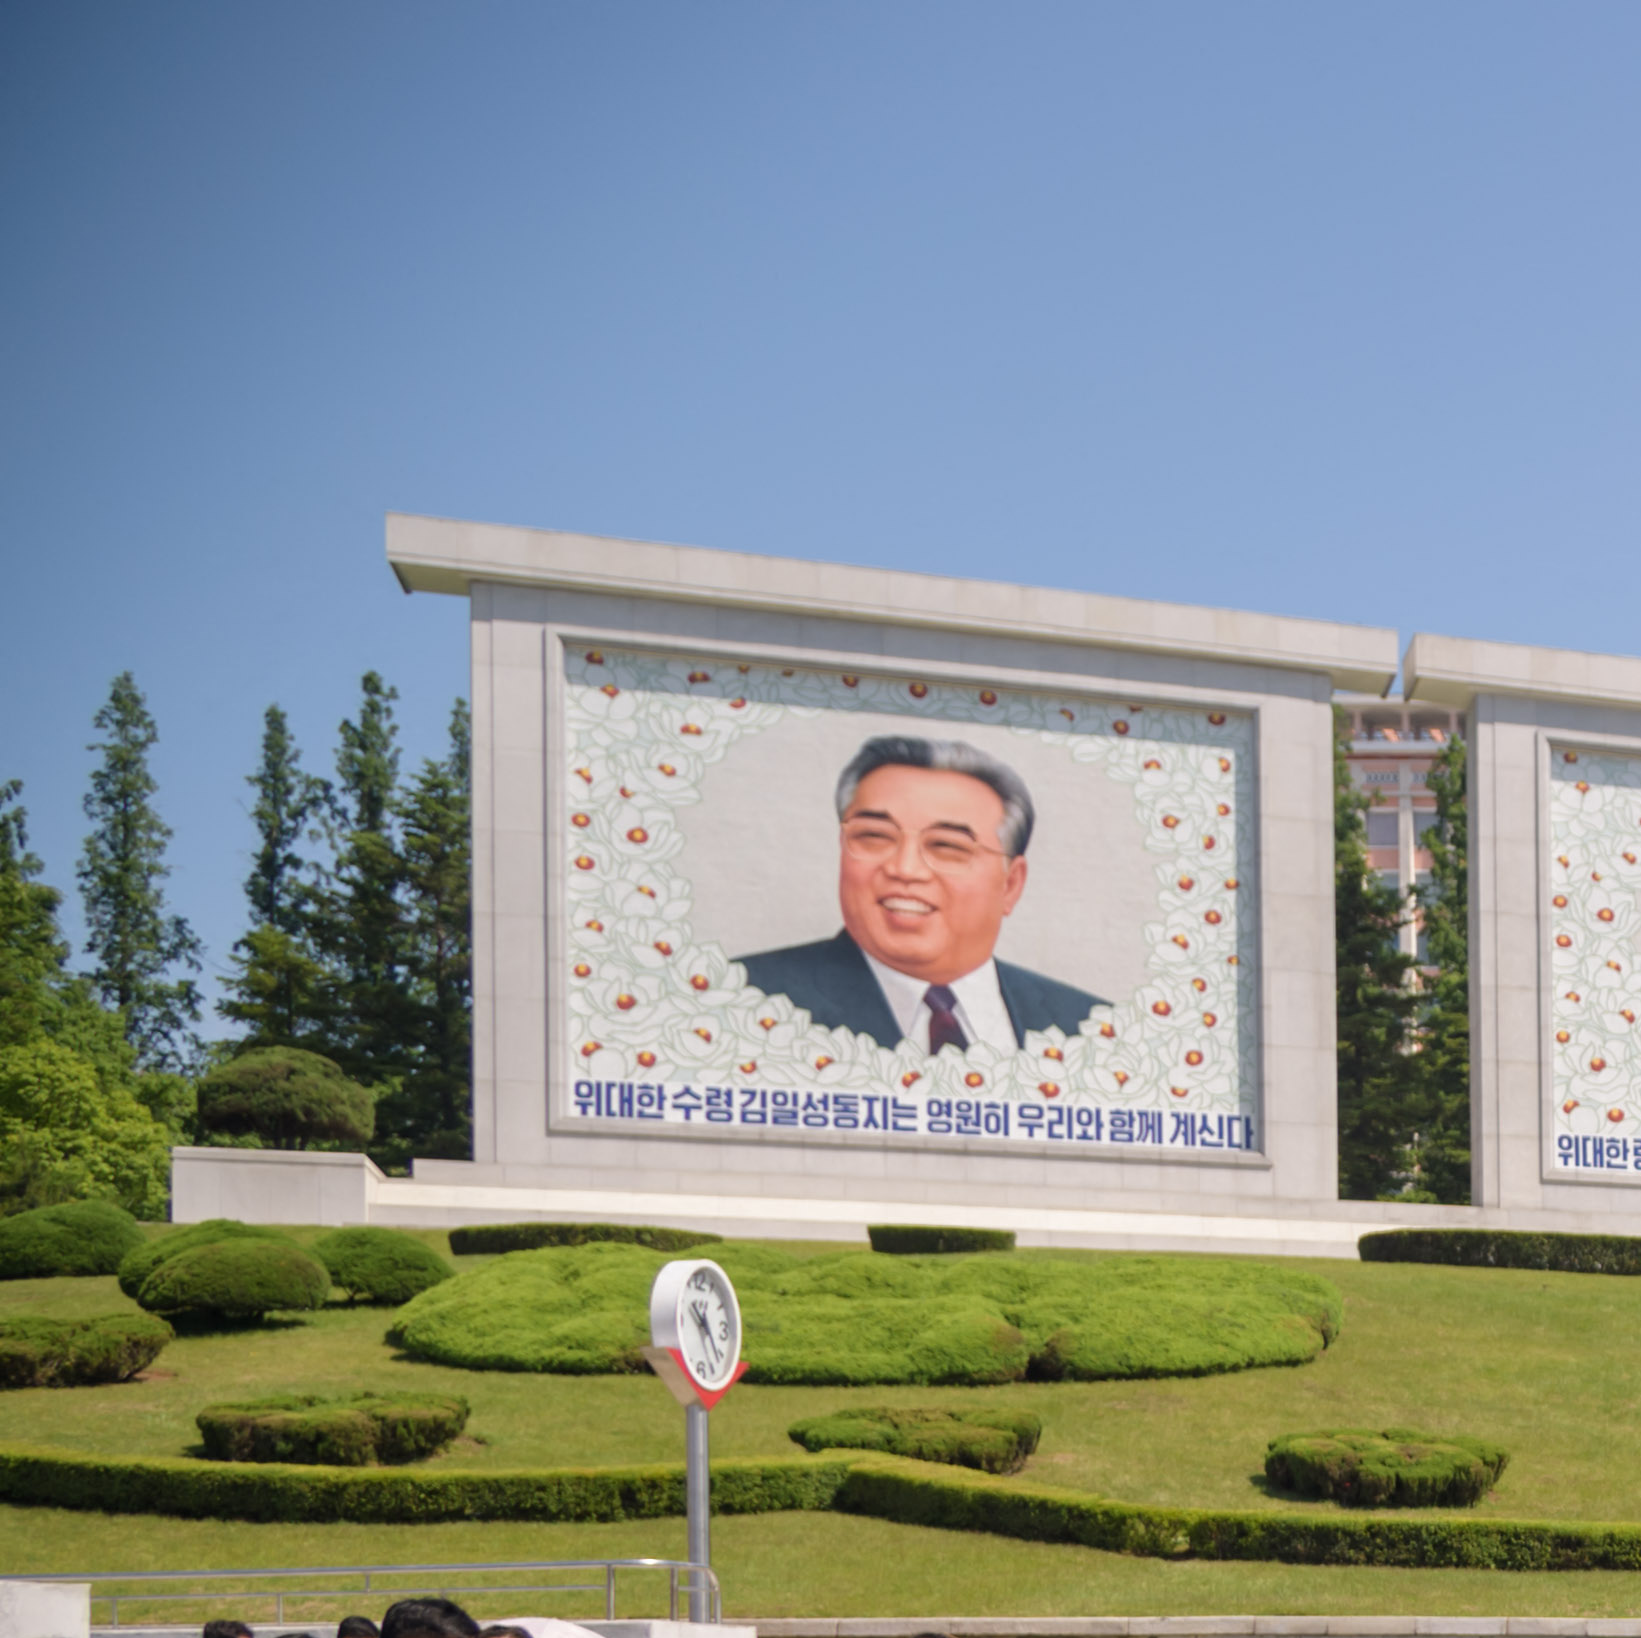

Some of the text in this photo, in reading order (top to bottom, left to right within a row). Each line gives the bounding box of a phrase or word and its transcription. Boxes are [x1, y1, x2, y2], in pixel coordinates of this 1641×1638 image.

[574, 1081, 1254, 1149] 위대한 수령 김일성동지는 영원히 우리와 함께 계신다
[1557, 1134, 1630, 1169] 위대한
